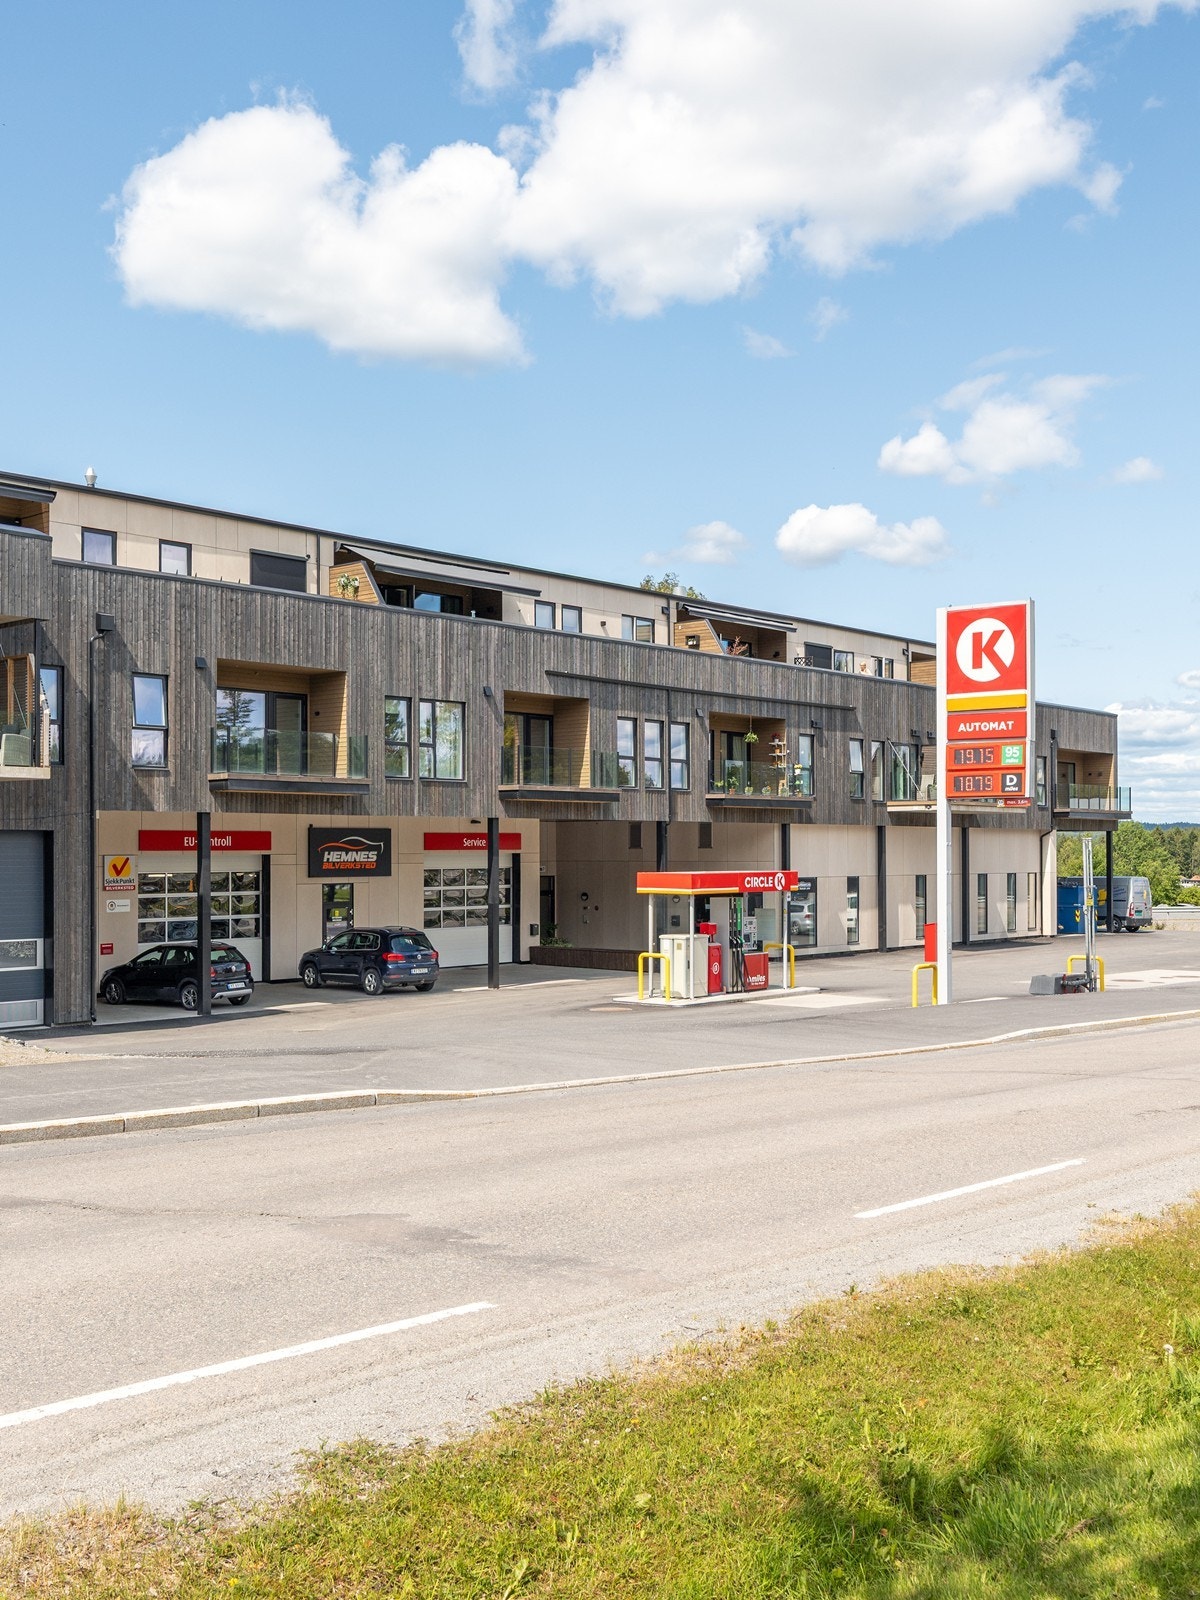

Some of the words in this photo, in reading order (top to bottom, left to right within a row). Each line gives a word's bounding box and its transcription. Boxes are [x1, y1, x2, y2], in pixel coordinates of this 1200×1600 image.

[970, 627, 1010, 677] K
[957, 721, 1014, 732] AUTOMAT
[1005, 746, 1020, 758] 95
[1006, 775, 1017, 786] D
[184, 836, 232, 847] EU-ntroll
[463, 838, 487, 847] Service
[323, 851, 378, 862] HEMNES
[322, 862, 377, 870] BILVERKSTED
[744, 876, 774, 888] CIRCLE
[775, 874, 785, 890] K
